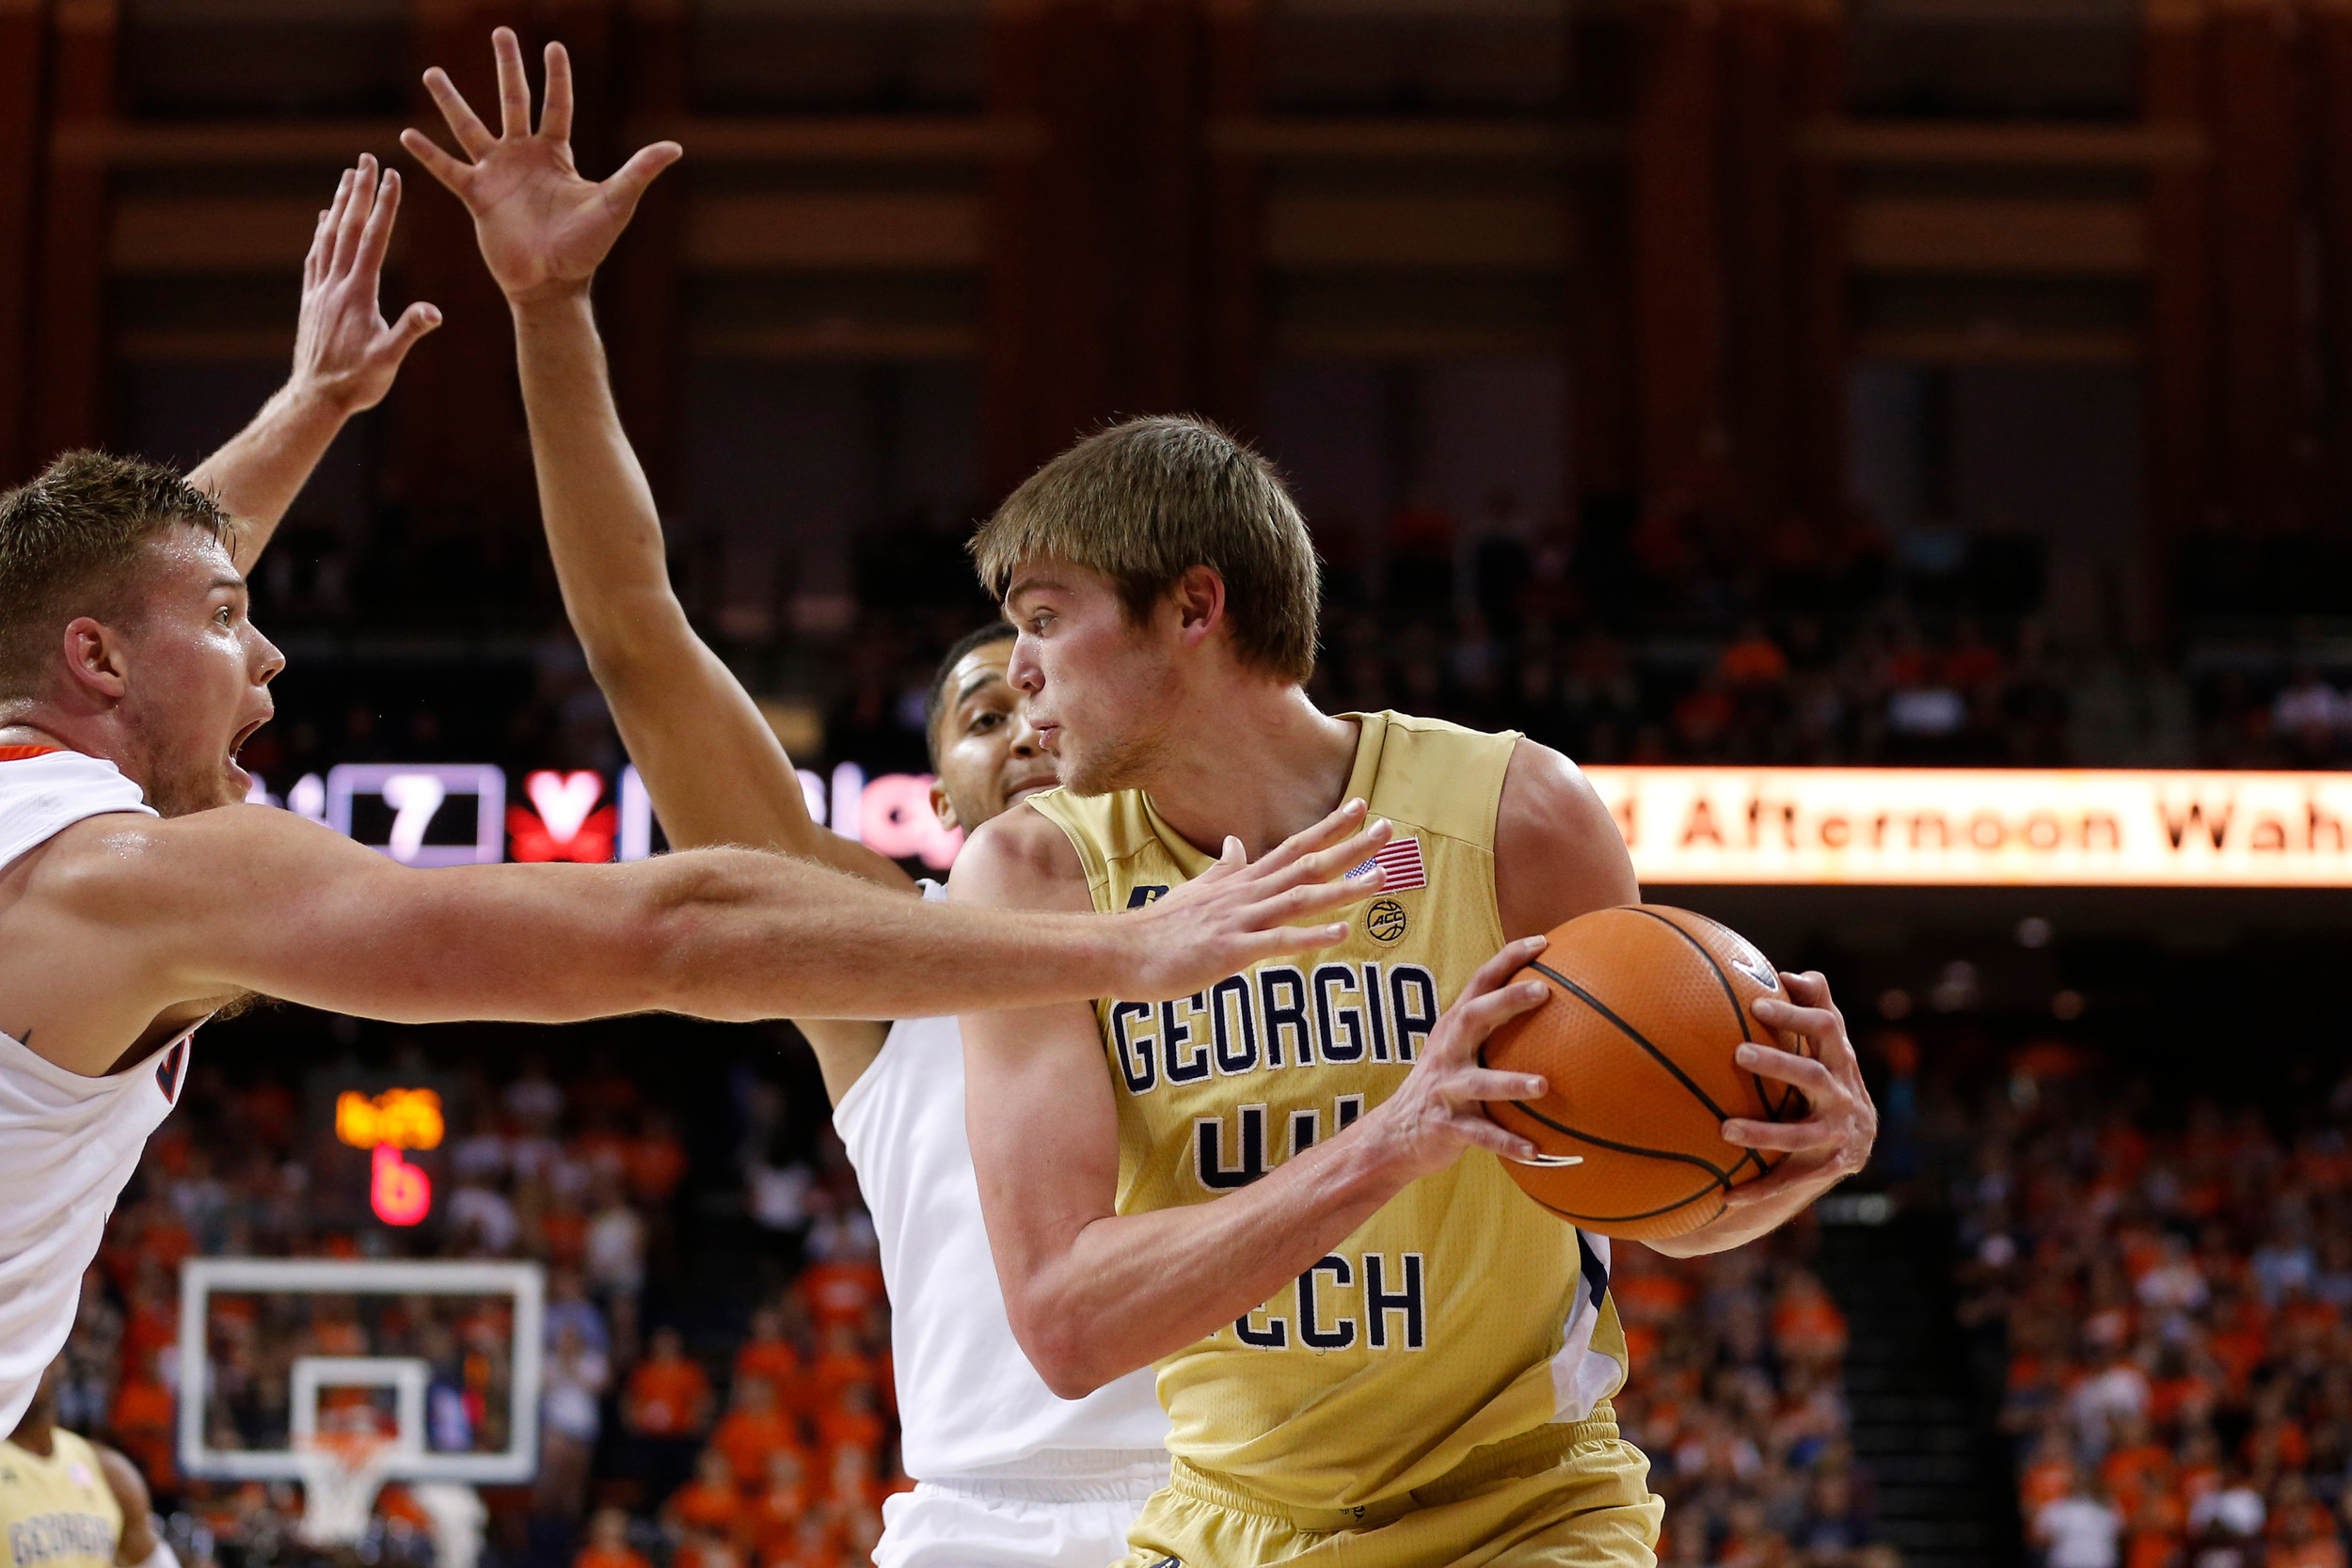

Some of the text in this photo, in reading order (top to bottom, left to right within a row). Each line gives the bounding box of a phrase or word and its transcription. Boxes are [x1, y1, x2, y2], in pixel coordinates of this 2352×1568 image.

[382, 774, 445, 863] 7
[1678, 798, 2122, 849] Afternoon
[1371, 910, 1404, 927] ACC
[1110, 961, 1441, 1096] GEORGIA
[1206, 1252, 1427, 1352] CH
